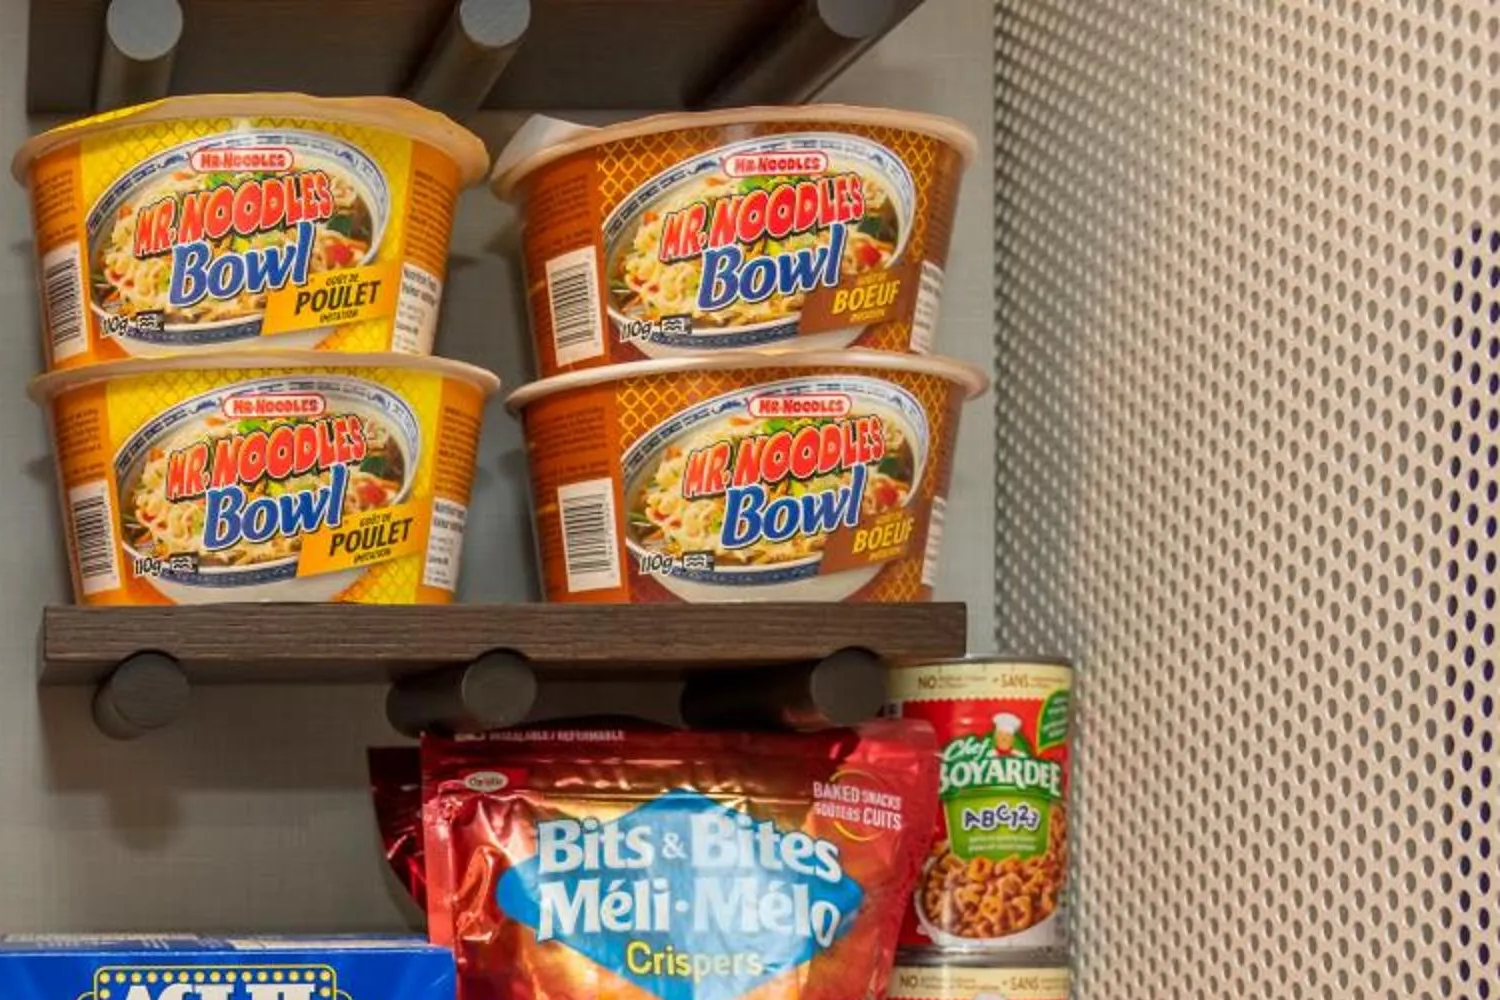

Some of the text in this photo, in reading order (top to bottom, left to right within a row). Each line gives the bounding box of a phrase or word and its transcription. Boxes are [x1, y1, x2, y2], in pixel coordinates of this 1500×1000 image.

[169, 221, 315, 307] Bowl
[697, 223, 847, 311] Bowl
[294, 280, 381, 316] POULET
[831, 279, 900, 316] BOEUF
[202, 463, 349, 551] Bowl
[721, 465, 867, 550] Bowl
[329, 517, 414, 557] POULET
[852, 518, 915, 555] BOEUF
[918, 675, 937, 690] NO
[813, 780, 860, 803] BAKED
[862, 808, 902, 832] CUITS
[537, 811, 843, 884] Bits & Bites
[626, 940, 764, 980] Crispers
[900, 974, 920, 989] NO
